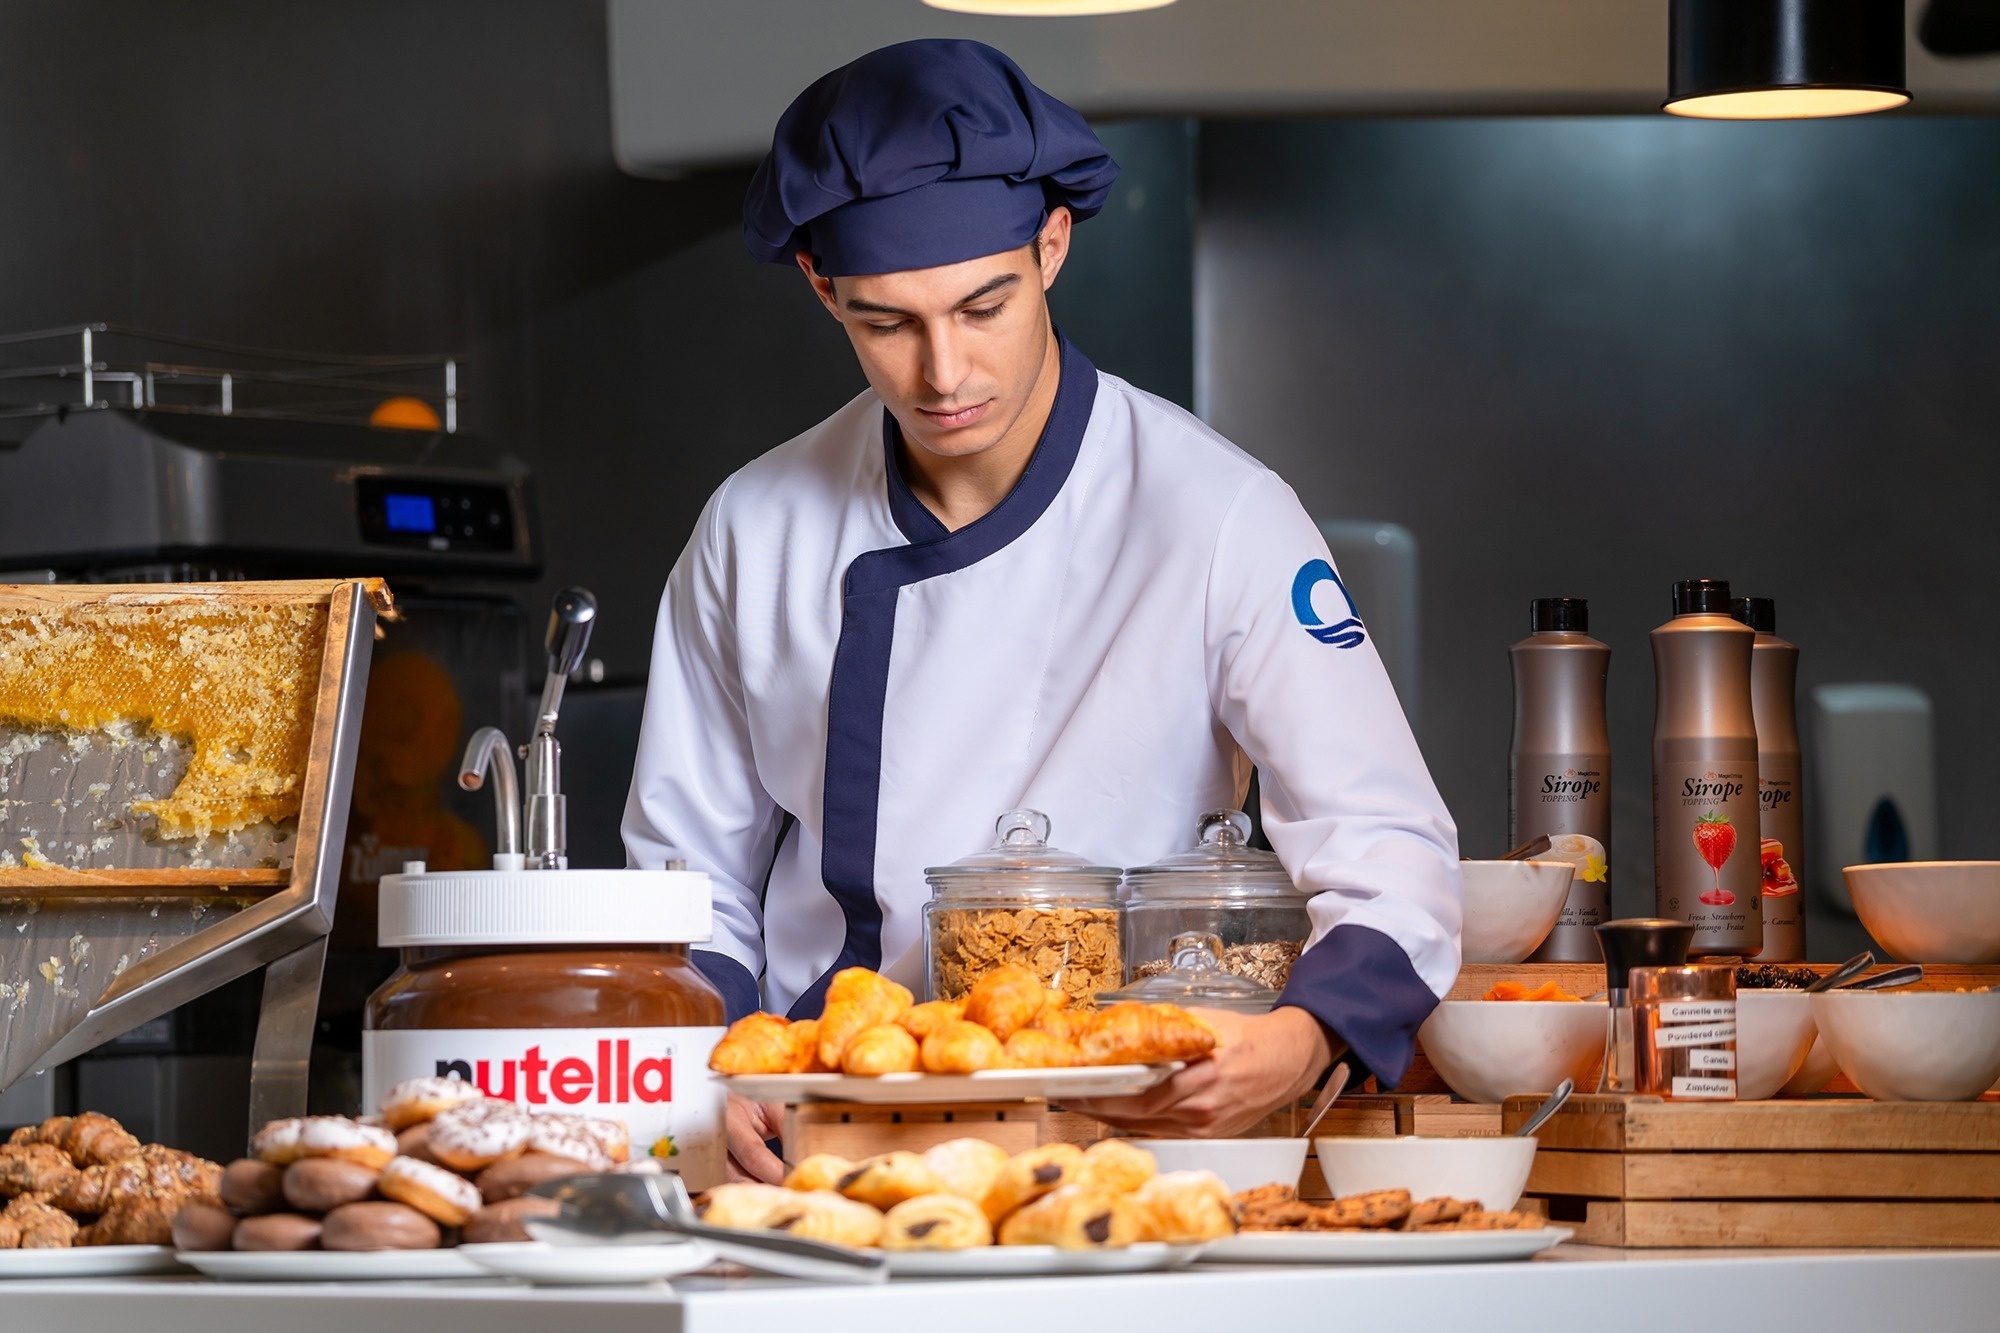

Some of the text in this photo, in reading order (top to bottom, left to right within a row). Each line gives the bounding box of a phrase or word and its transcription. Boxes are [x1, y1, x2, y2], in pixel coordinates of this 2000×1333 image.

[1541, 774, 1600, 799] Sirope
[1681, 778, 1743, 802] Sirope
[1682, 798, 1719, 806] TOPPING
[1688, 912, 1746, 922] Fresa Strawberry
[1672, 1007, 1711, 1016] Cannelle
[1667, 1030, 1713, 1042] Powdered
